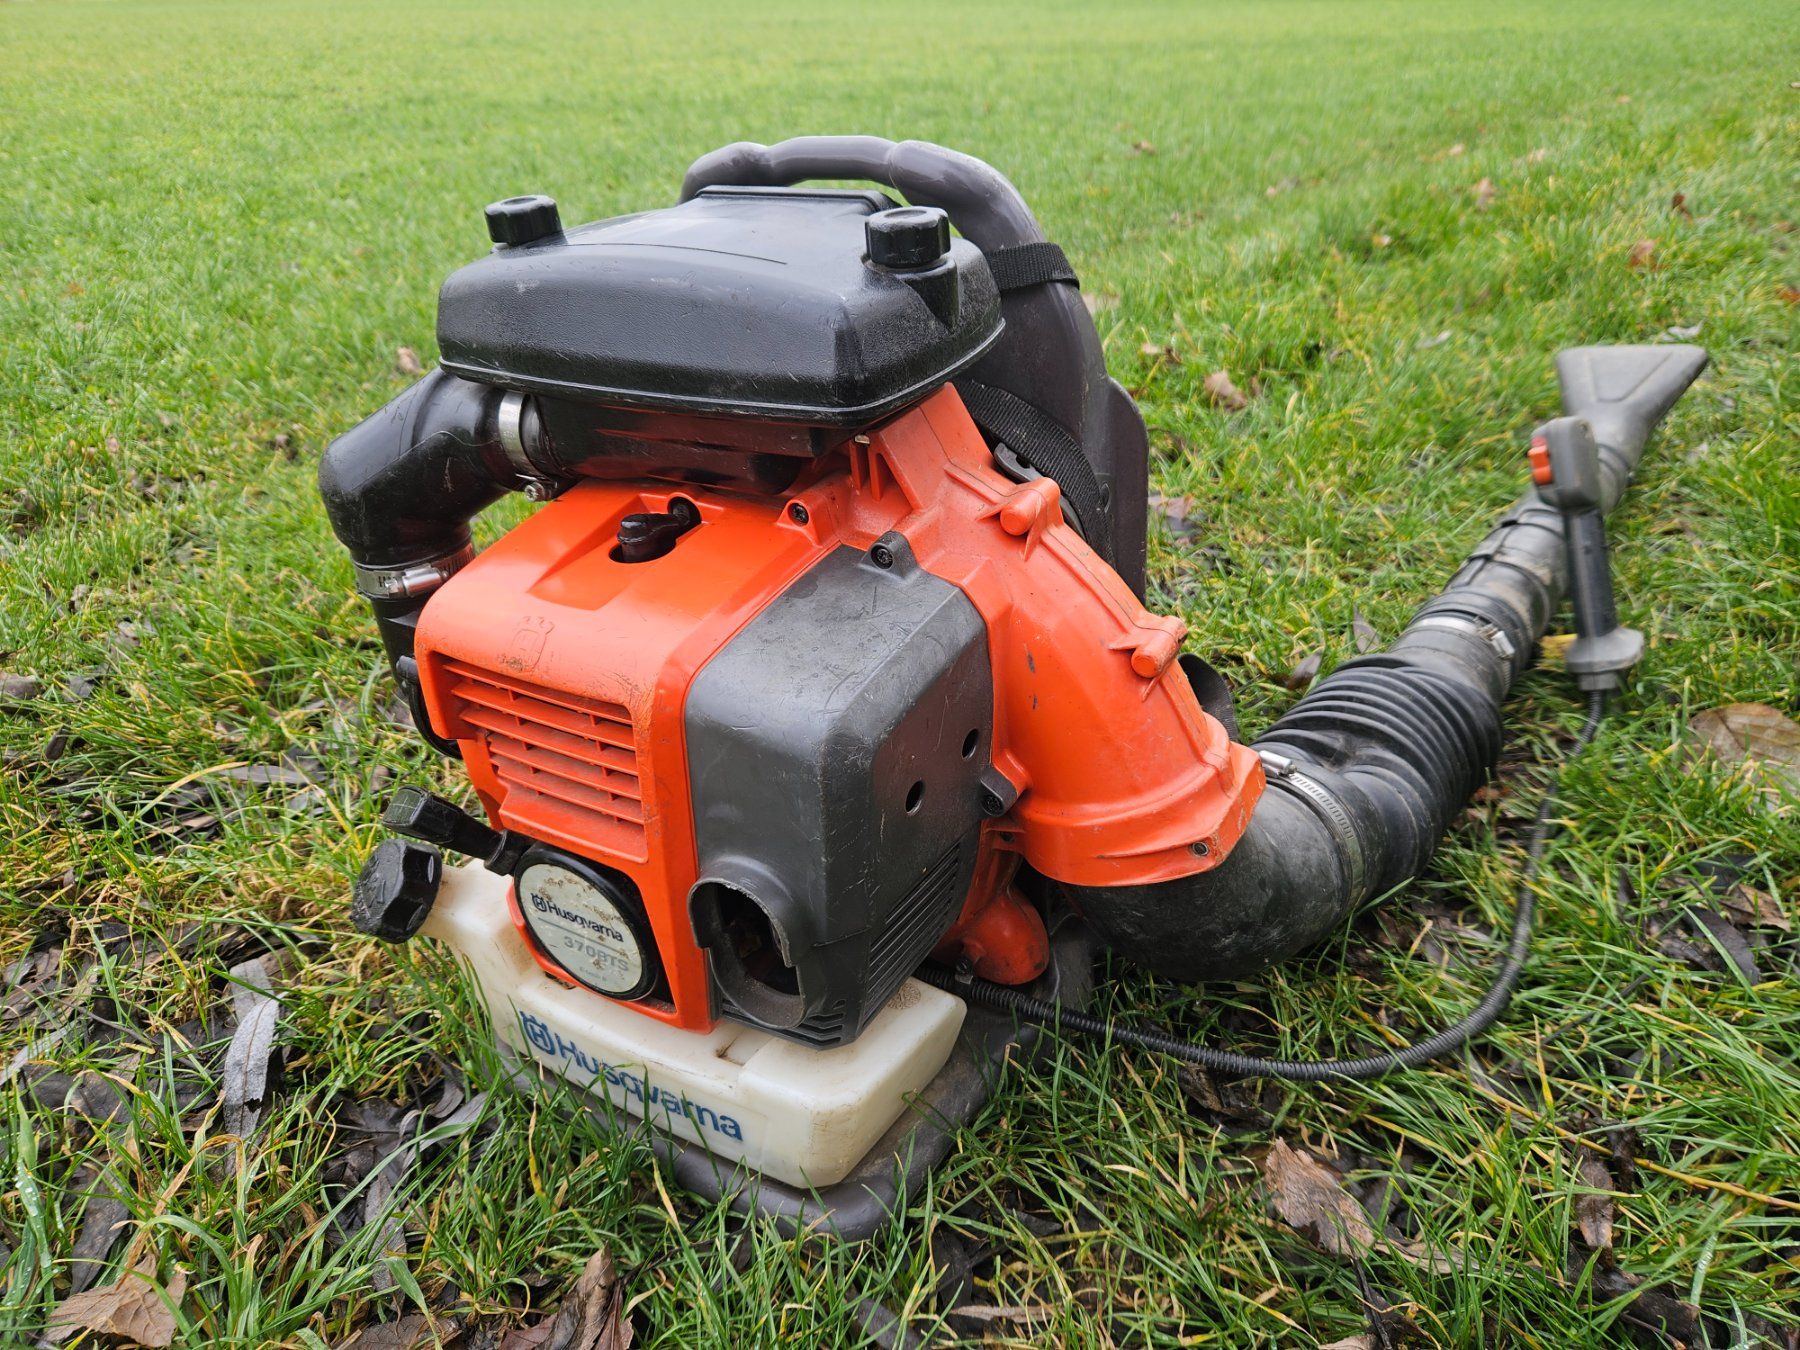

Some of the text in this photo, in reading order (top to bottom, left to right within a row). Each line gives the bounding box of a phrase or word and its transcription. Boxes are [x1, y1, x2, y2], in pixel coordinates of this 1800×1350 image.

[547, 900, 624, 942] Husqvarna
[564, 936, 629, 971] 370BTS
[555, 1032, 743, 1141] Husqvarna
